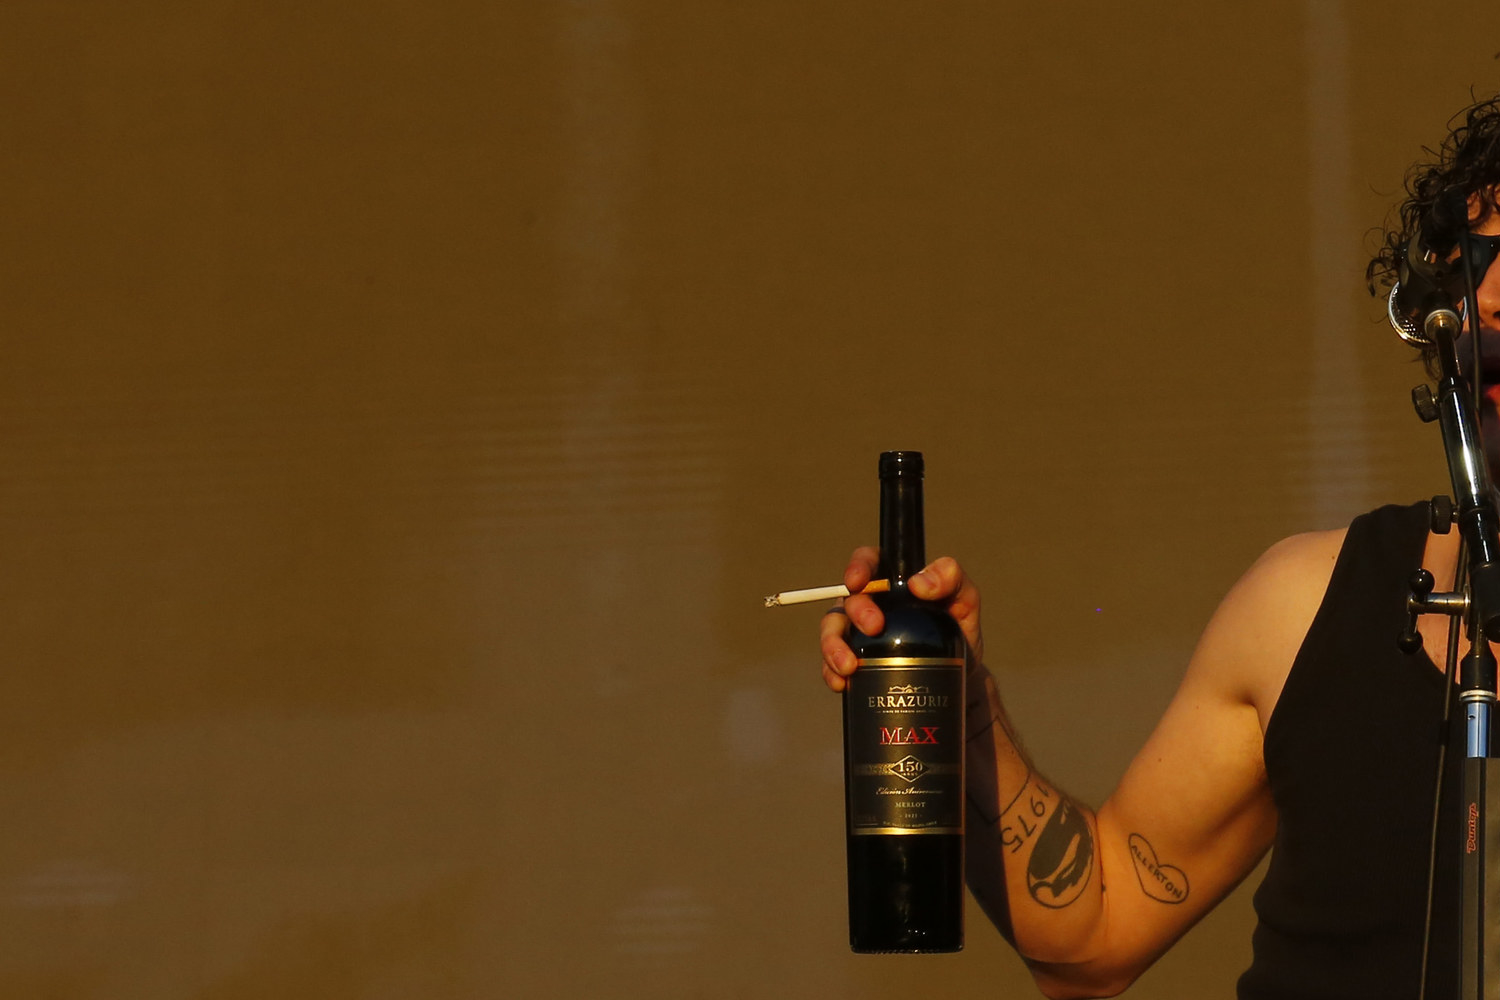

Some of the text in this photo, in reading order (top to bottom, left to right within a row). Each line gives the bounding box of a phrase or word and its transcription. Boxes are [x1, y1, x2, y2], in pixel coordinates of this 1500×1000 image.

[868, 695, 949, 708] ERRAZURIZ
[880, 727, 939, 745] MAX
[900, 760, 923, 772] 150
[1466, 802, 1479, 854] Dunlop
[1131, 846, 1182, 897] ALLERTON
